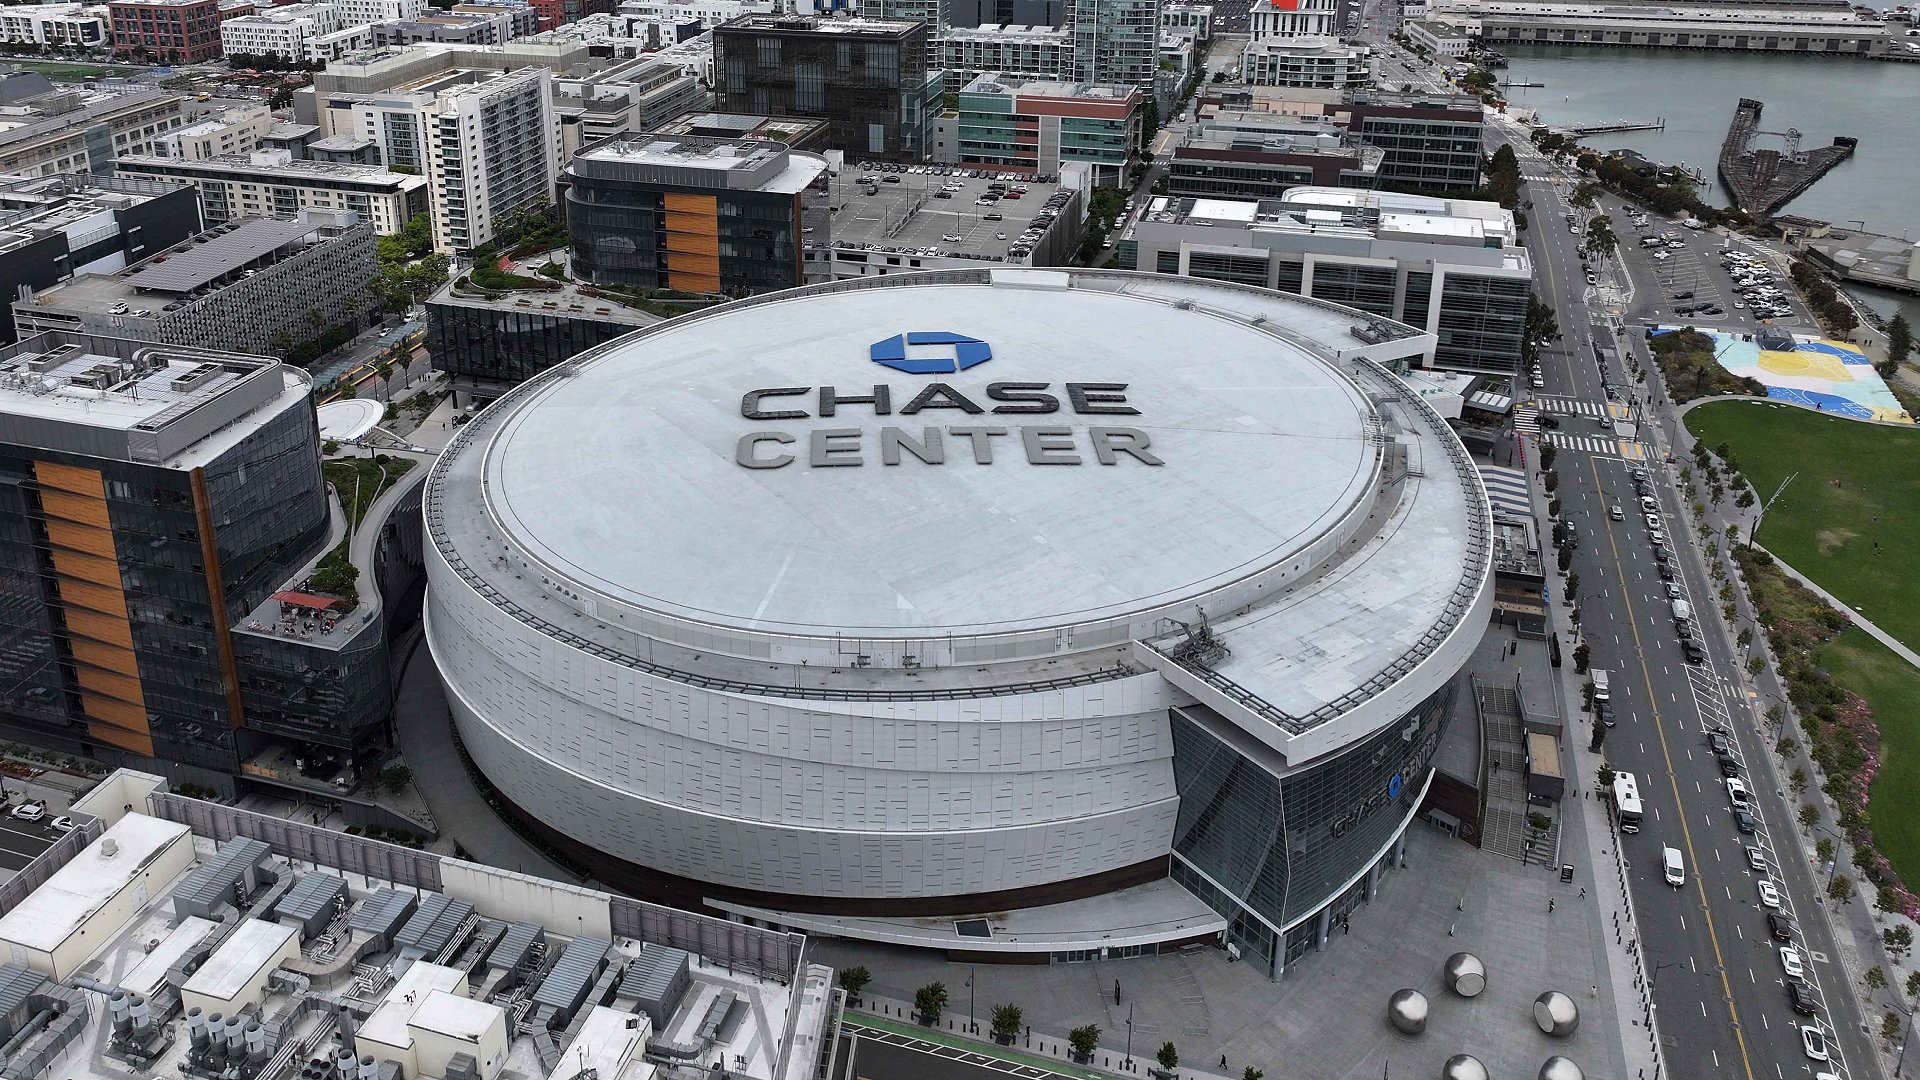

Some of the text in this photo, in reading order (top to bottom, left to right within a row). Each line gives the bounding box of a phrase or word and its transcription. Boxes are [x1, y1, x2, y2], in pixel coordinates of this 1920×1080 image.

[741, 381, 1142, 420] CHASE
[736, 425, 1165, 469] CENTER
[1333, 732, 1437, 838] CHASE CENTER
